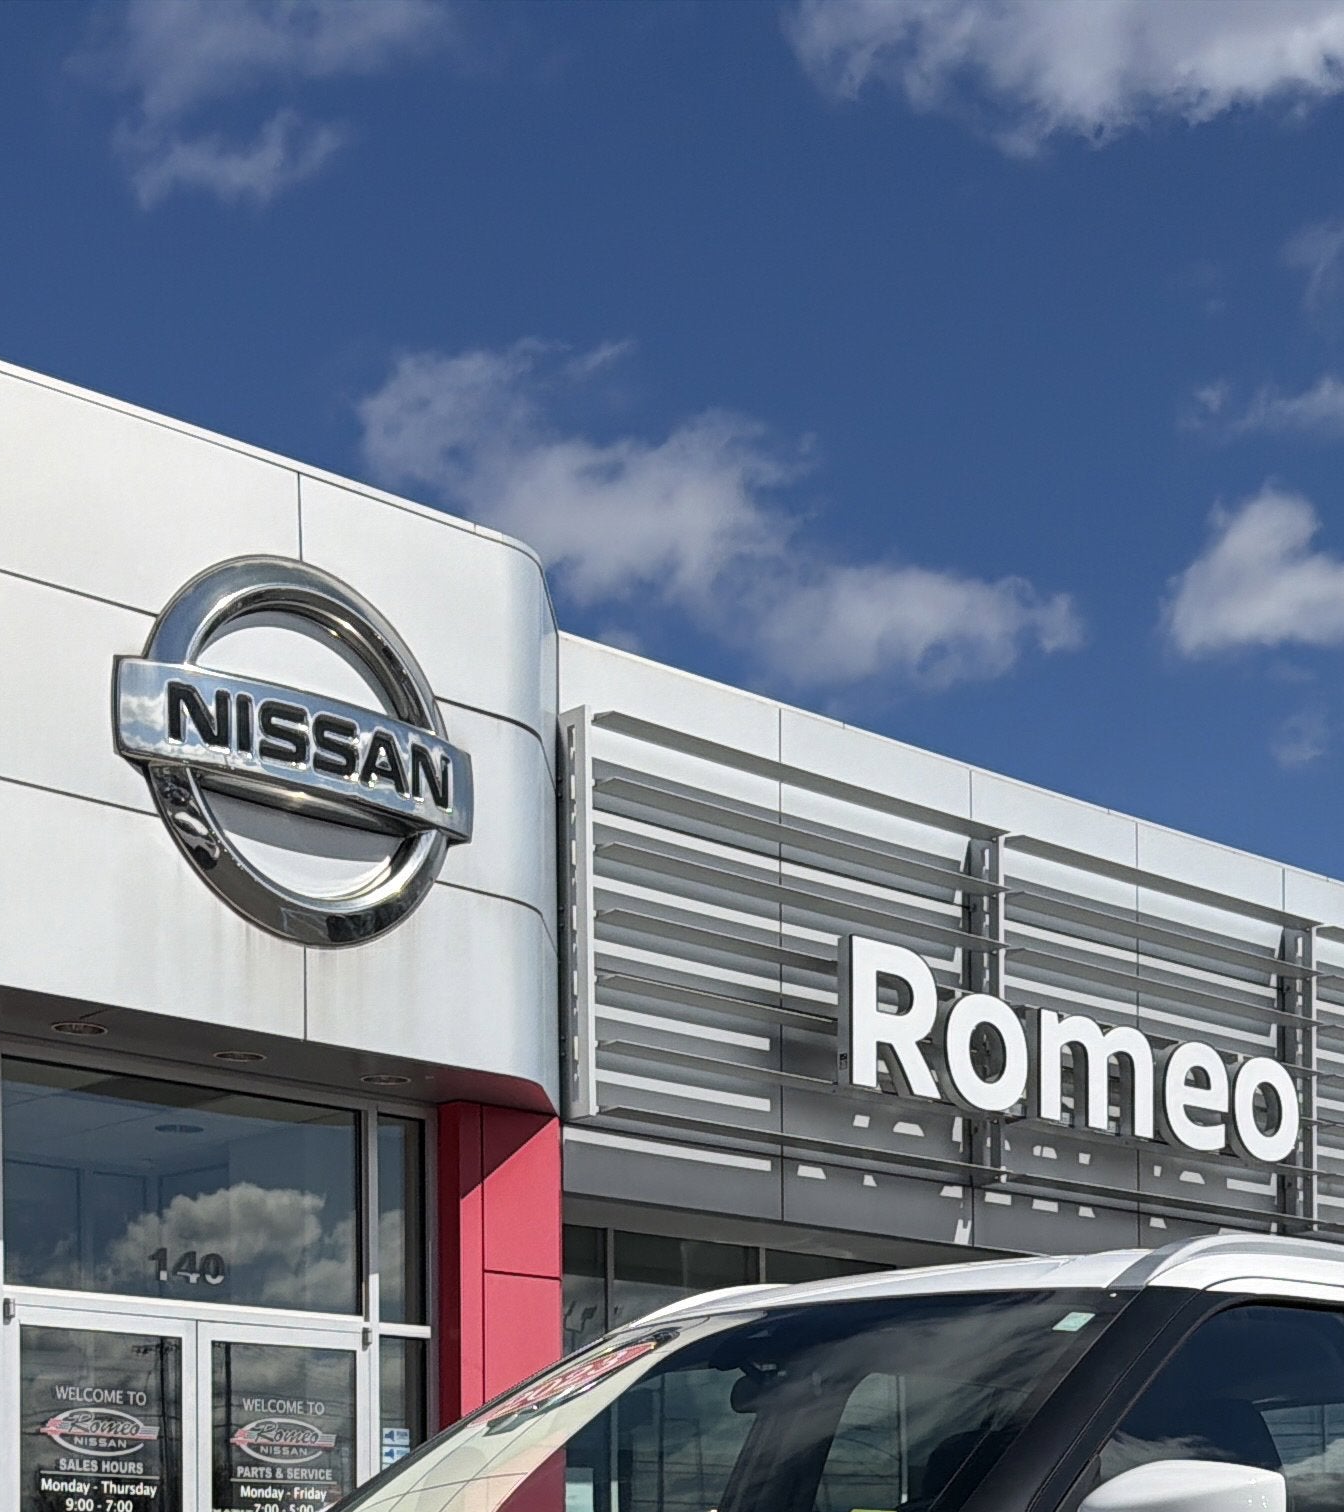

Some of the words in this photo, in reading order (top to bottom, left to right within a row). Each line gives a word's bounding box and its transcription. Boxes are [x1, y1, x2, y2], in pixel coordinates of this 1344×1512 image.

[167, 681, 454, 813] NISSAN
[846, 933, 1300, 1162] Romeo
[148, 1247, 225, 1285] 140
[56, 1385, 123, 1404] WELCOME
[127, 1391, 147, 1406] TO
[242, 1398, 304, 1415] WELCOME
[306, 1401, 326, 1416] TO
[66, 1410, 142, 1437] Romeo
[253, 1421, 320, 1444] Romeo
[74, 1436, 127, 1449] NISSAN
[259, 1445, 308, 1456] NISSAN
[59, 1458, 99, 1472] SALES
[101, 1460, 144, 1475] HOURS
[236, 1466, 273, 1479] PARTS
[276, 1467, 284, 1479] &
[286, 1468, 333, 1481] SERVICE
[41, 1478, 90, 1495] Monday
[101, 1480, 157, 1499] Thursday
[240, 1485, 284, 1501] Monday
[293, 1487, 327, 1502] Friday
[65, 1498, 94, 1512] 9:00
[105, 1500, 134, 1512] 7:00
